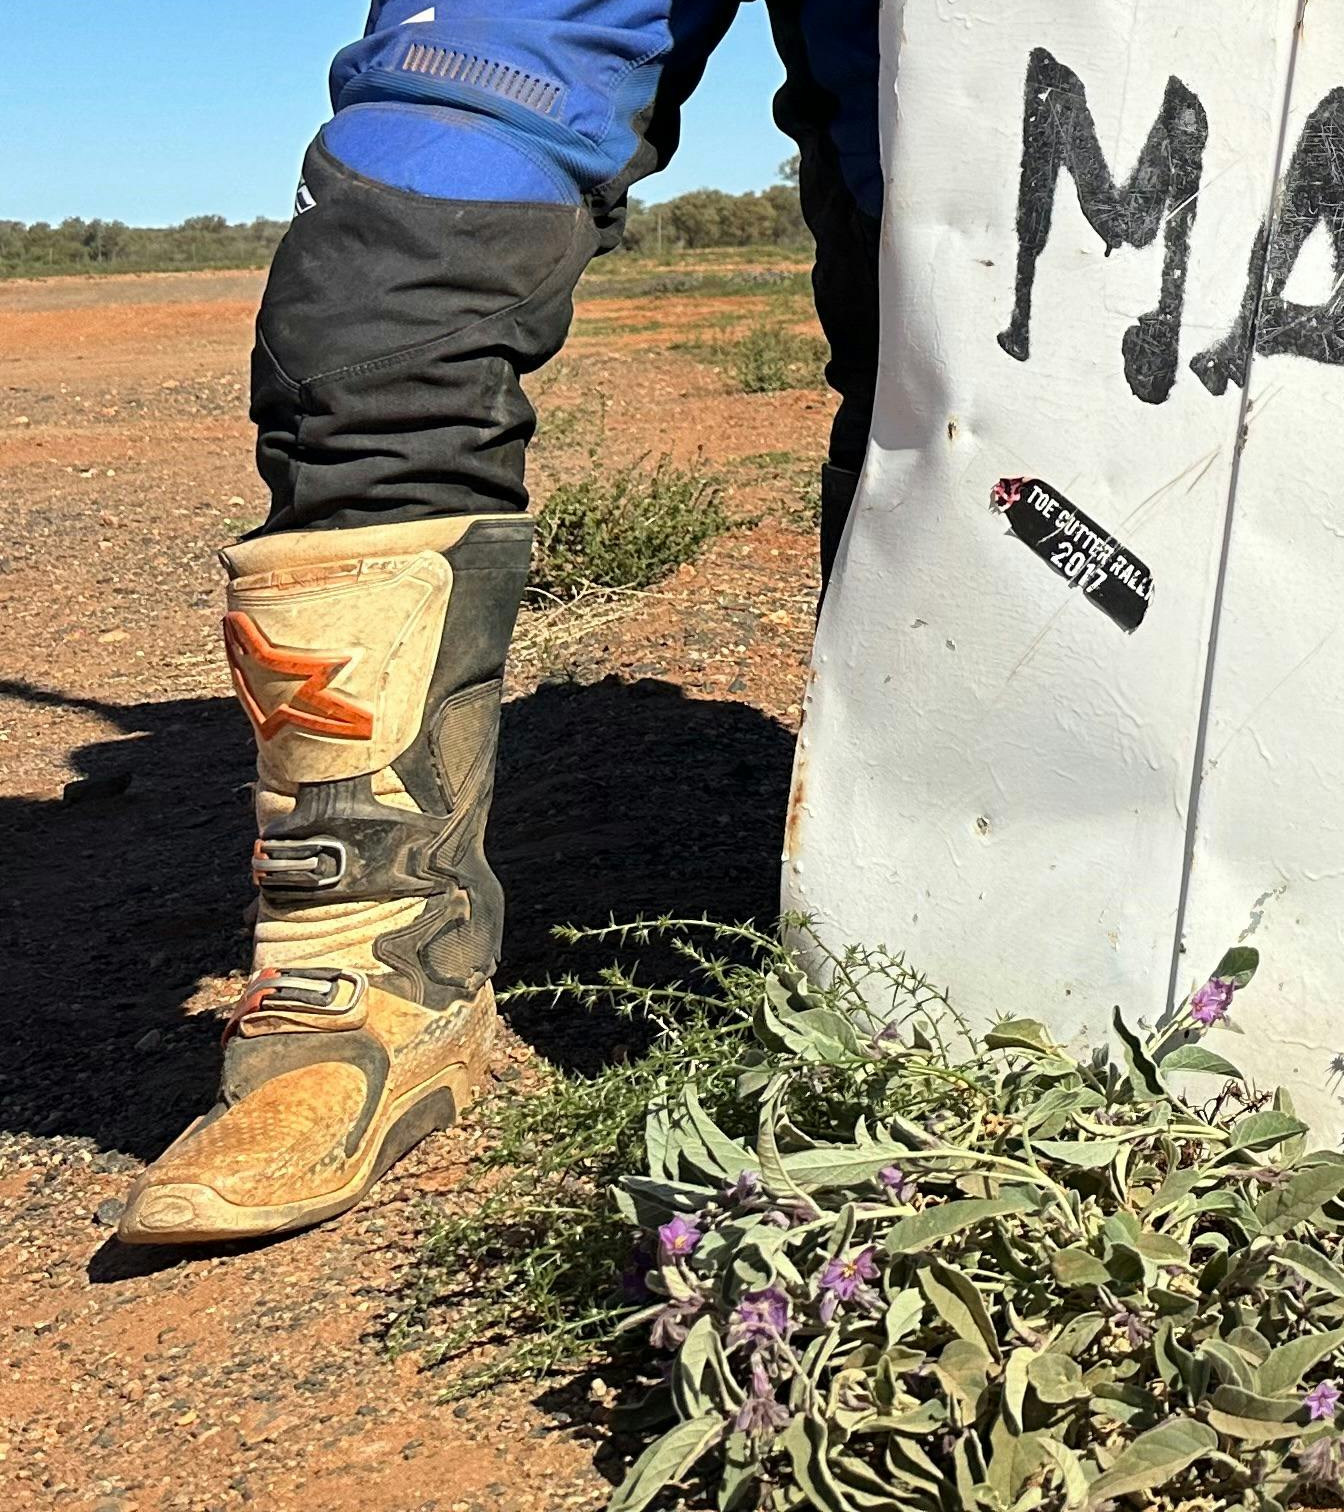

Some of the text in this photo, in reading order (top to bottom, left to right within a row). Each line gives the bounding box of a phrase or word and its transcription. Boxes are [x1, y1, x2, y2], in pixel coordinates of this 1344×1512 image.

[1026, 485, 1061, 519] TOE
[1055, 509, 1115, 564] CUTTER
[1050, 541, 1108, 593] 2017
